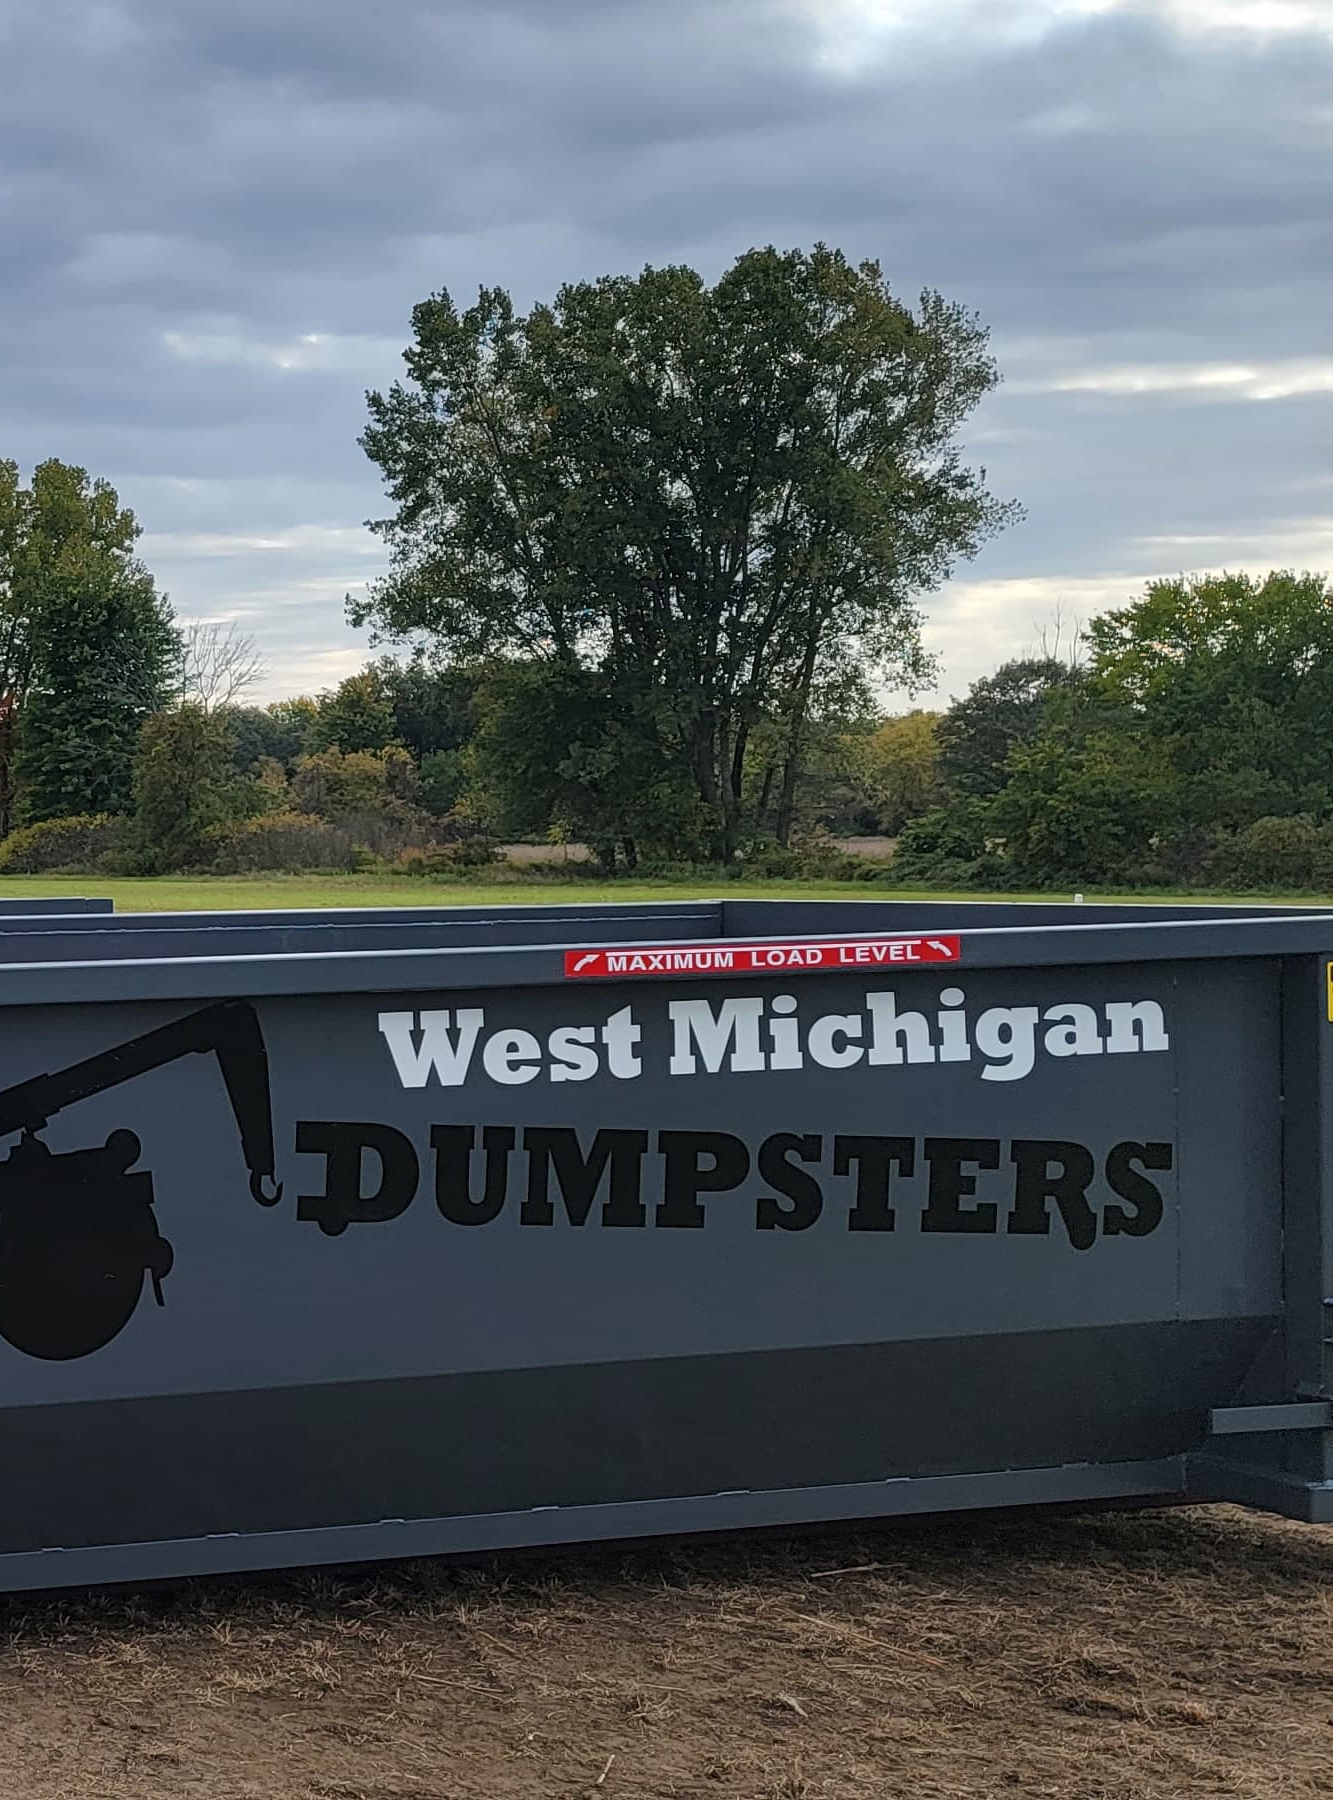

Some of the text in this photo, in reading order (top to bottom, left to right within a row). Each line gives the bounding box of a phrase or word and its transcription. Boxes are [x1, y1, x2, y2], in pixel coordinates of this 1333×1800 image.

[607, 944, 920, 972] MAXIMUM LOAD LEVEL
[377, 987, 1170, 1090] West Michigan
[295, 1120, 1173, 1252] DUMPSTERS
